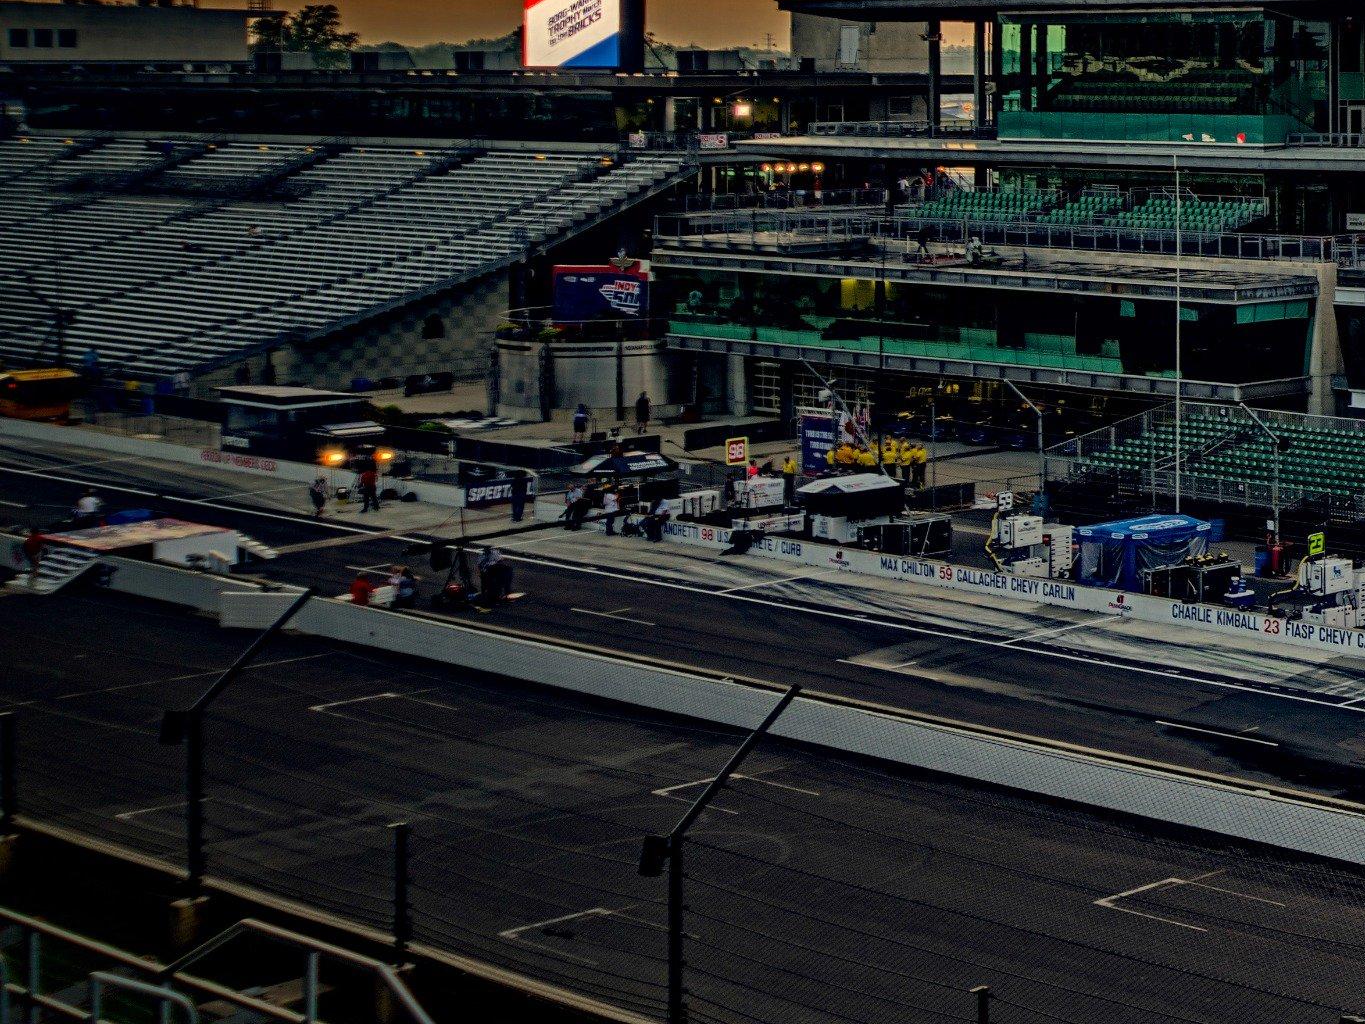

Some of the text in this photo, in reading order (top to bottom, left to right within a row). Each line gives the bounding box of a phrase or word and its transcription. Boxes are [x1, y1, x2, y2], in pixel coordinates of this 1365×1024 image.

[548, 10, 581, 37] TROPHY
[568, 9, 602, 37] BRICKS
[728, 443, 745, 460] 98
[662, 521, 699, 539] ANDRETTI
[701, 528, 714, 541] 98
[781, 540, 802, 556] CURB
[880, 556, 1075, 601] MAX CHILTON 59 GALLAGHER CHEVY CARLIN
[1172, 604, 1212, 623] CHARLIE
[1216, 609, 1259, 632] KIMBALL
[1264, 619, 1280, 635] 23
[1285, 621, 1314, 641] FIASP
[1319, 628, 1353, 647] CHEVY
